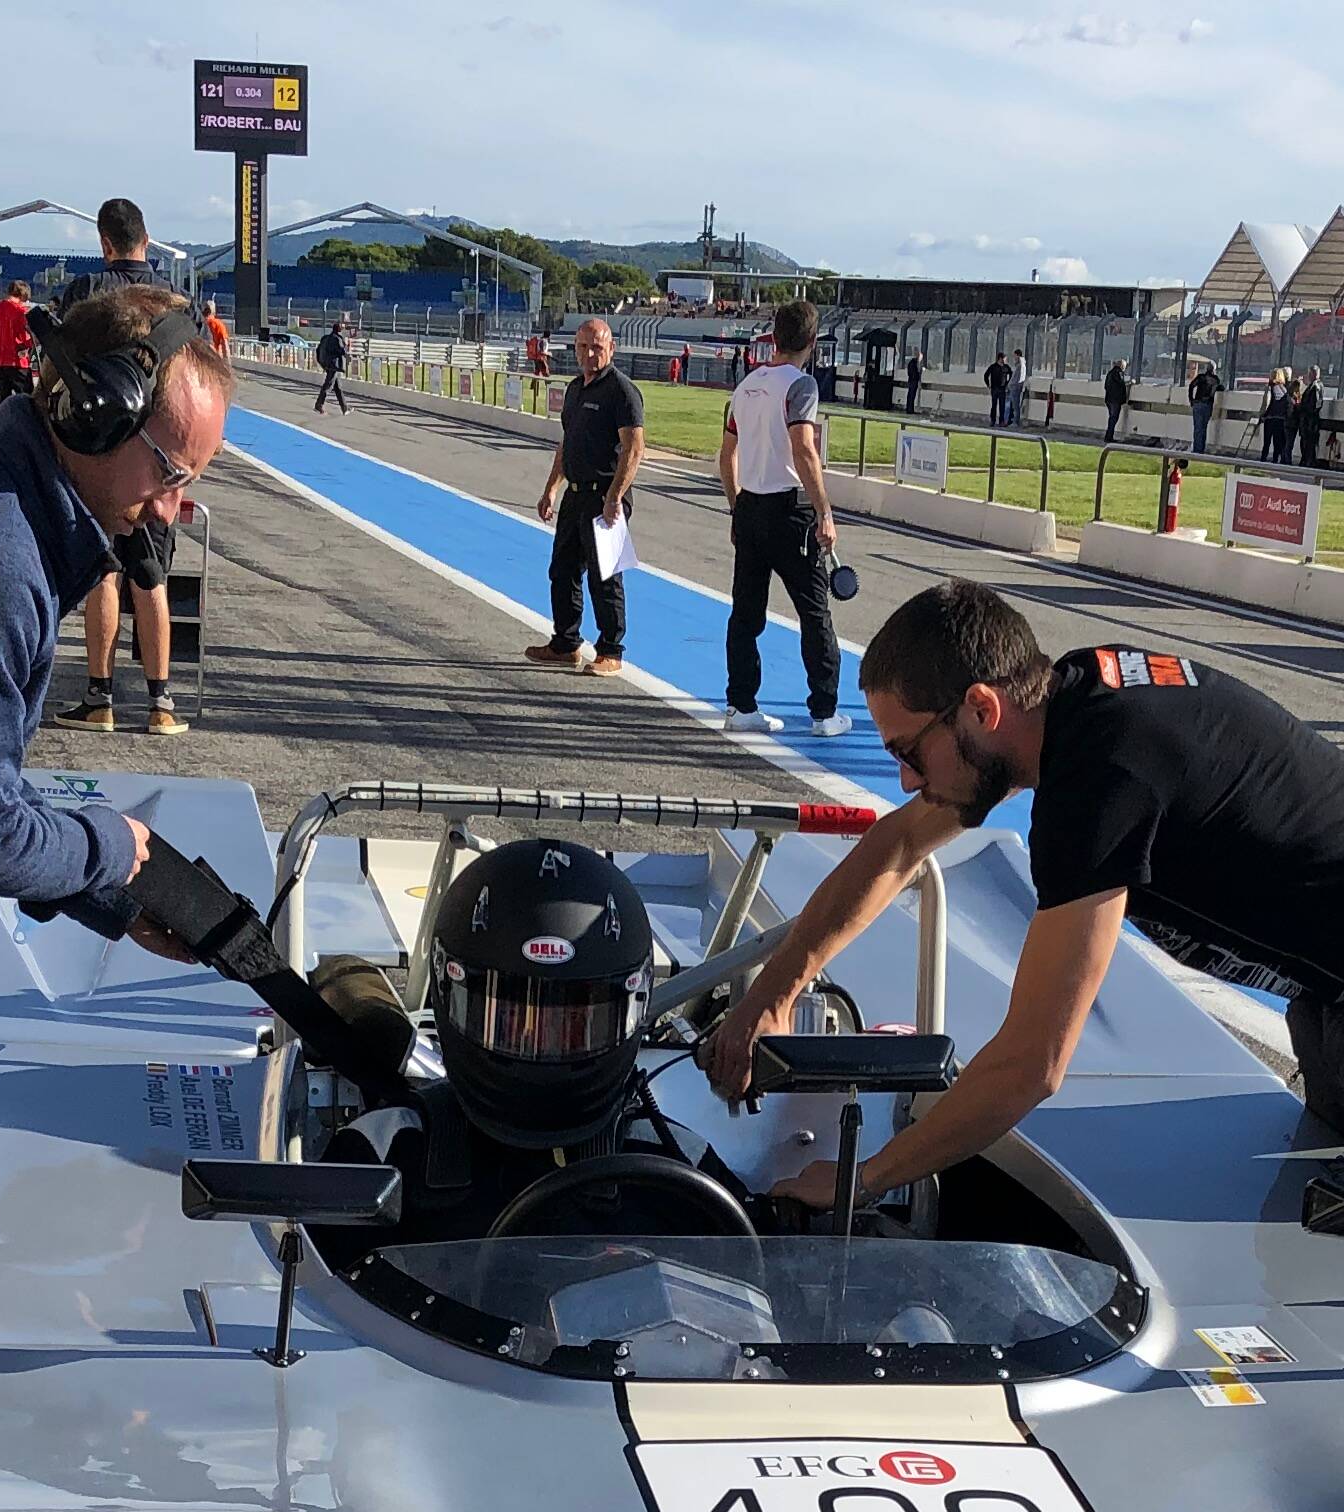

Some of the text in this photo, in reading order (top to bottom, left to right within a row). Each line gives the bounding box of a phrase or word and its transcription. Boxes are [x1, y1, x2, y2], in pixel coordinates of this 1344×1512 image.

[212, 63, 289, 76] RICHARD MILLE
[200, 83, 223, 97] 121
[235, 87, 262, 98] 0.304
[277, 86, 297, 102] 12
[274, 117, 302, 132] BAU
[530, 943, 568, 955] BELL
[746, 1455, 877, 1478] EFG
